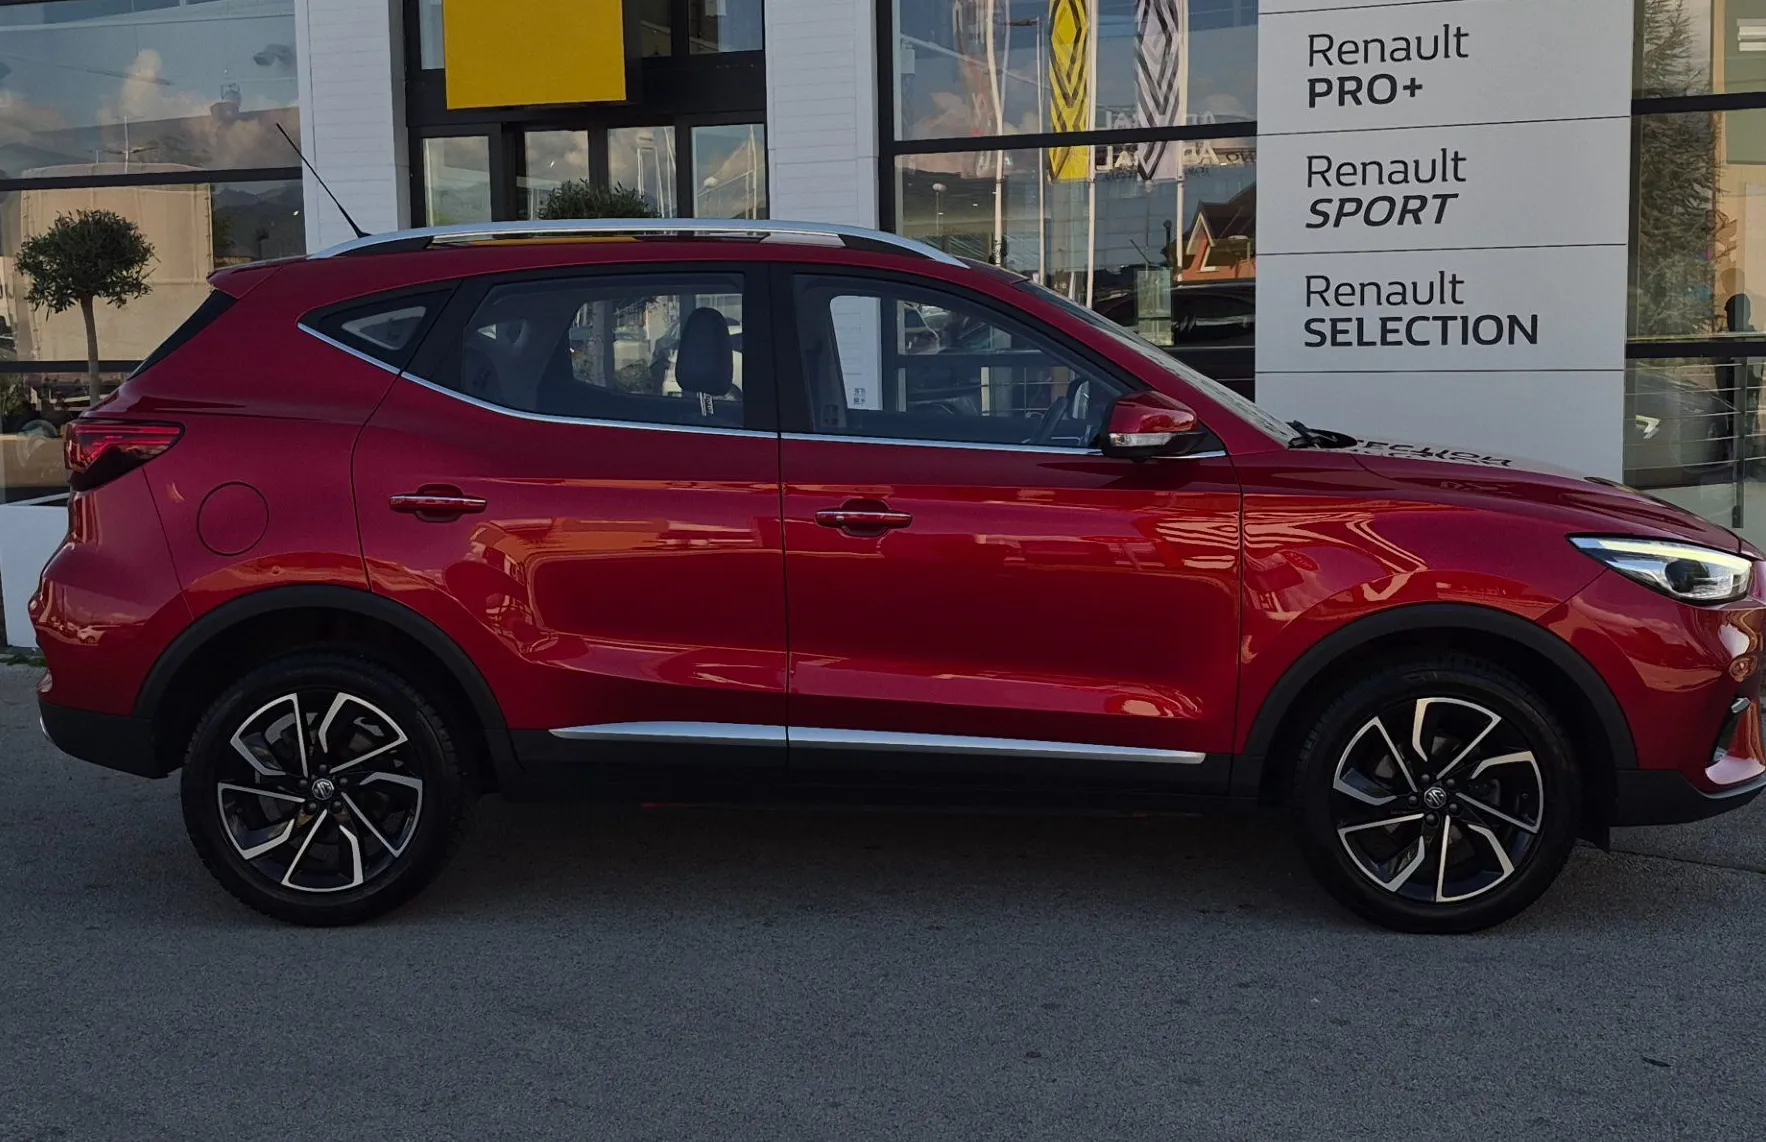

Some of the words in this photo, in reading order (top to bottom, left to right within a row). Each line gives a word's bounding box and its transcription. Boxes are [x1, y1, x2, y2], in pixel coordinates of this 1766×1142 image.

[1308, 24, 1469, 67] Renault
[1308, 74, 1422, 108] PRO+
[1307, 148, 1466, 187] Renault
[1305, 193, 1459, 228] SPORT
[1306, 271, 1464, 307] Renault
[1305, 314, 1537, 347] SELECTION
